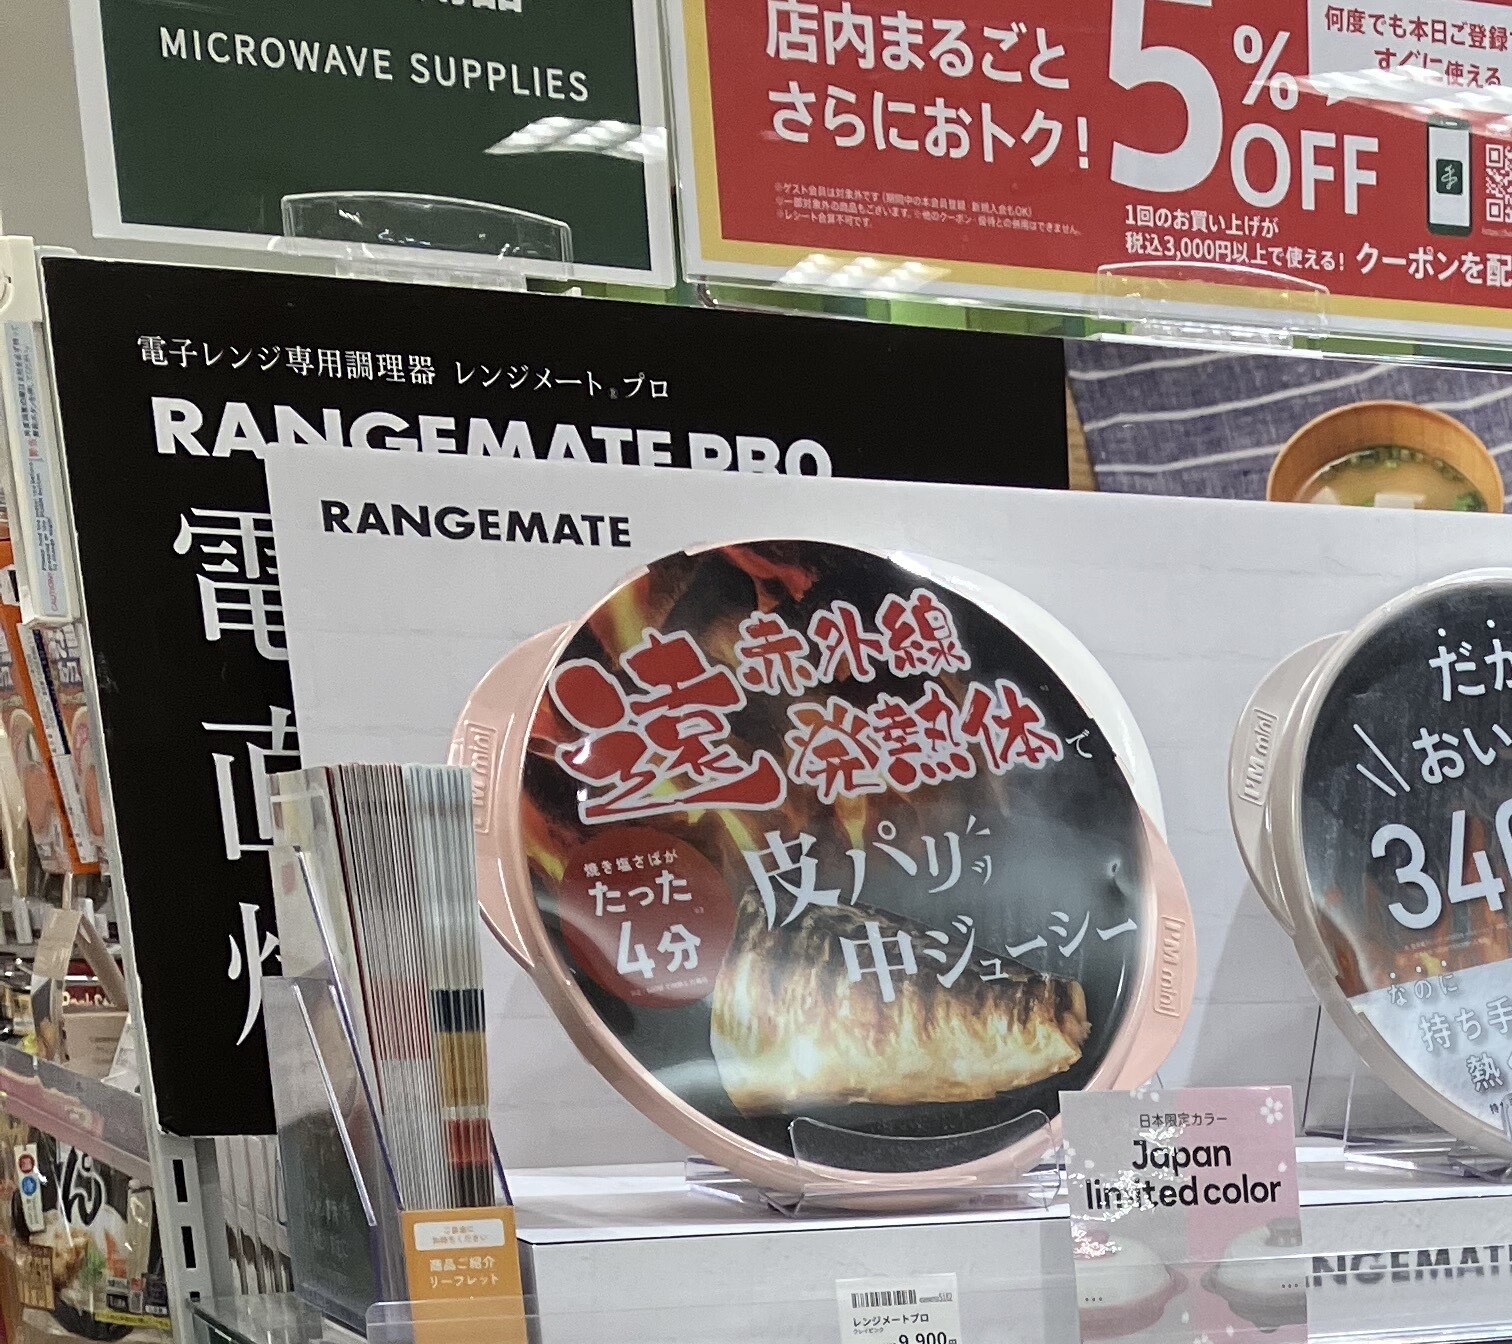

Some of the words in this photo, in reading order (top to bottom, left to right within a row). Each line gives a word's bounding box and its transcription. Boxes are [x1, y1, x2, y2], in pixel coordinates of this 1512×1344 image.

[160, 26, 393, 81] MICROWAVE
[410, 52, 589, 102] SUPPLIES
[766, 0, 1072, 91] 店内まるごと
[1109, 0, 1223, 192] 5
[1230, 121, 1380, 215] OFF
[1125, 203, 1279, 239] 1回のお買い上げが
[136, 335, 436, 385] 電子レンジ専用調理器
[320, 499, 631, 547] RANGEMATE
[736, 587, 970, 698] 赤外線
[584, 848, 678, 878] 焼き塩さばが
[588, 868, 693, 916] たった
[616, 924, 702, 981] 4分
[843, 905, 1138, 1003] 中ジューシー
[1139, 1110, 1228, 1130] 日本限定カラー
[1130, 1137, 1233, 1173] Japan
[1085, 1175, 1200, 1211] limited
[1202, 1175, 1283, 1208] color
[430, 1273, 499, 1289] リーフレット
[853, 1313, 929, 1328] レンジメートプロ
